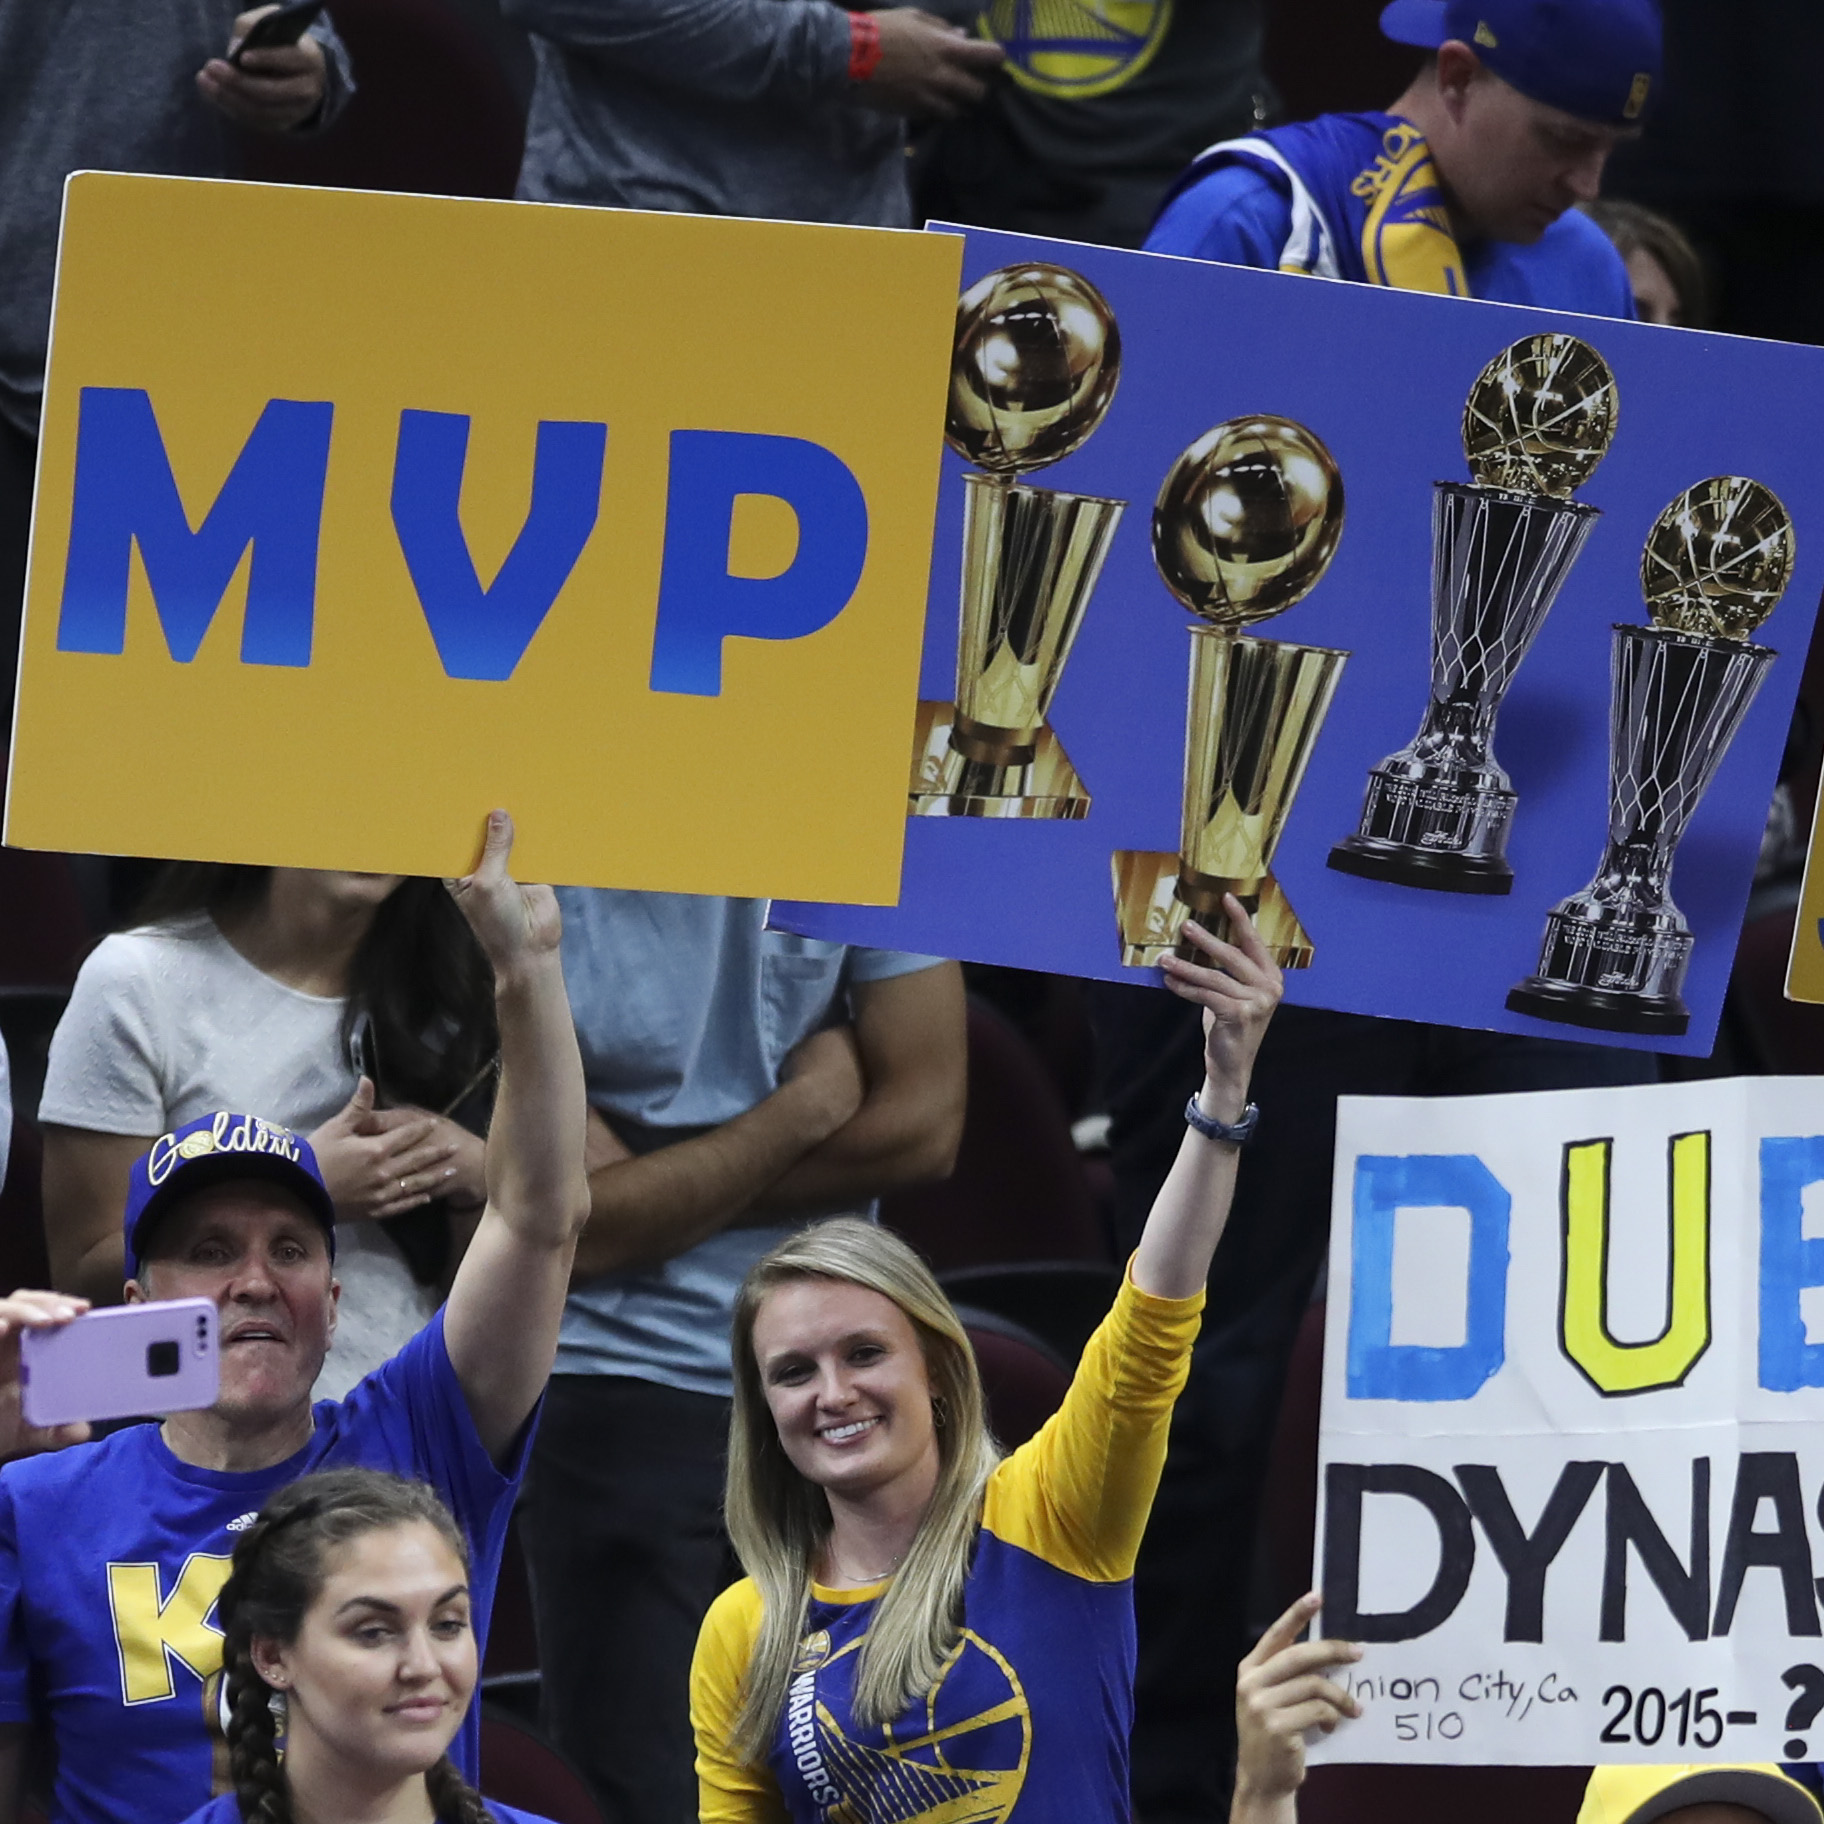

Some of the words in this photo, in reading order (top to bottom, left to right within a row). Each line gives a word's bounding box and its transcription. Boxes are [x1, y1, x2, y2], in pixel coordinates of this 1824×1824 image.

[56, 386, 868, 697] MVP
[788, 1669, 840, 1805] WARRIORS
[1395, 1711, 1464, 1741] 510
